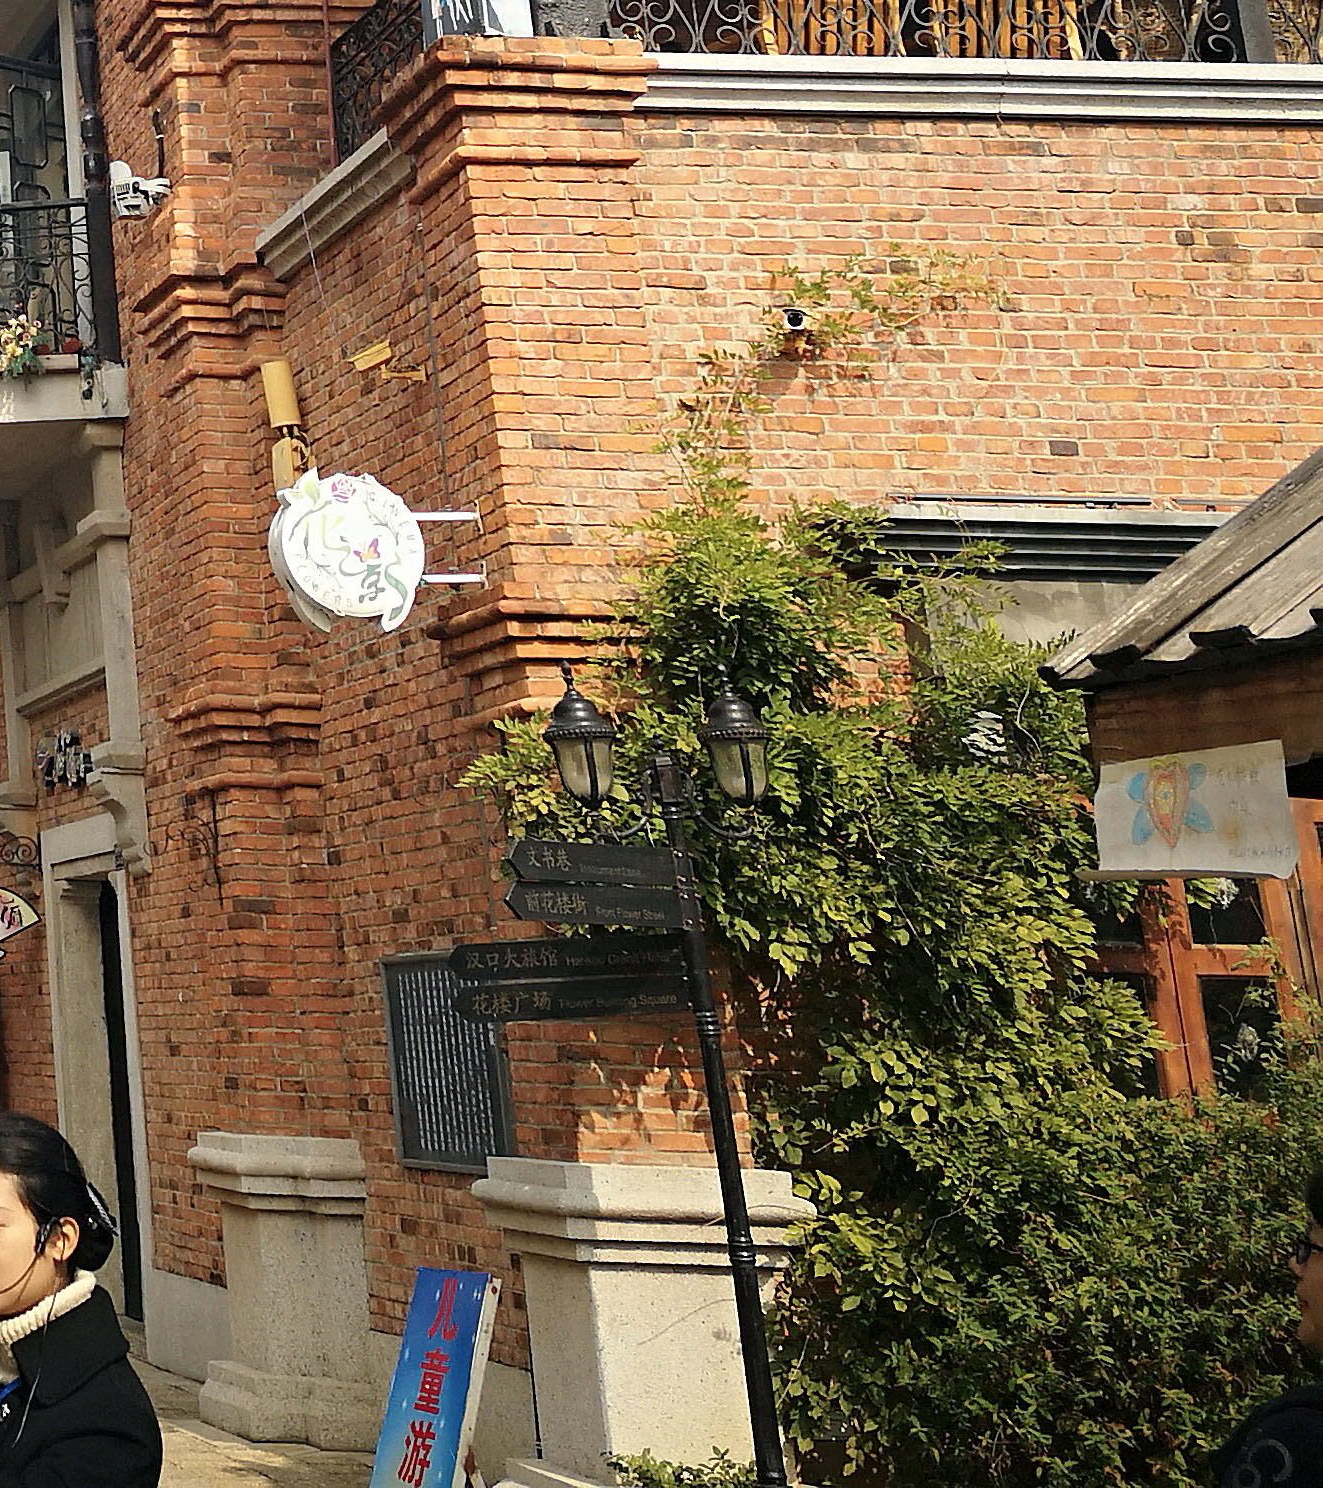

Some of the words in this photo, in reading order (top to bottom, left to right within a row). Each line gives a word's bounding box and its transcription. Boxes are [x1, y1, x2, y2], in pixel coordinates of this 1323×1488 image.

[471, 990, 552, 1016] 花楼广场
[638, 994, 677, 1009] Square
